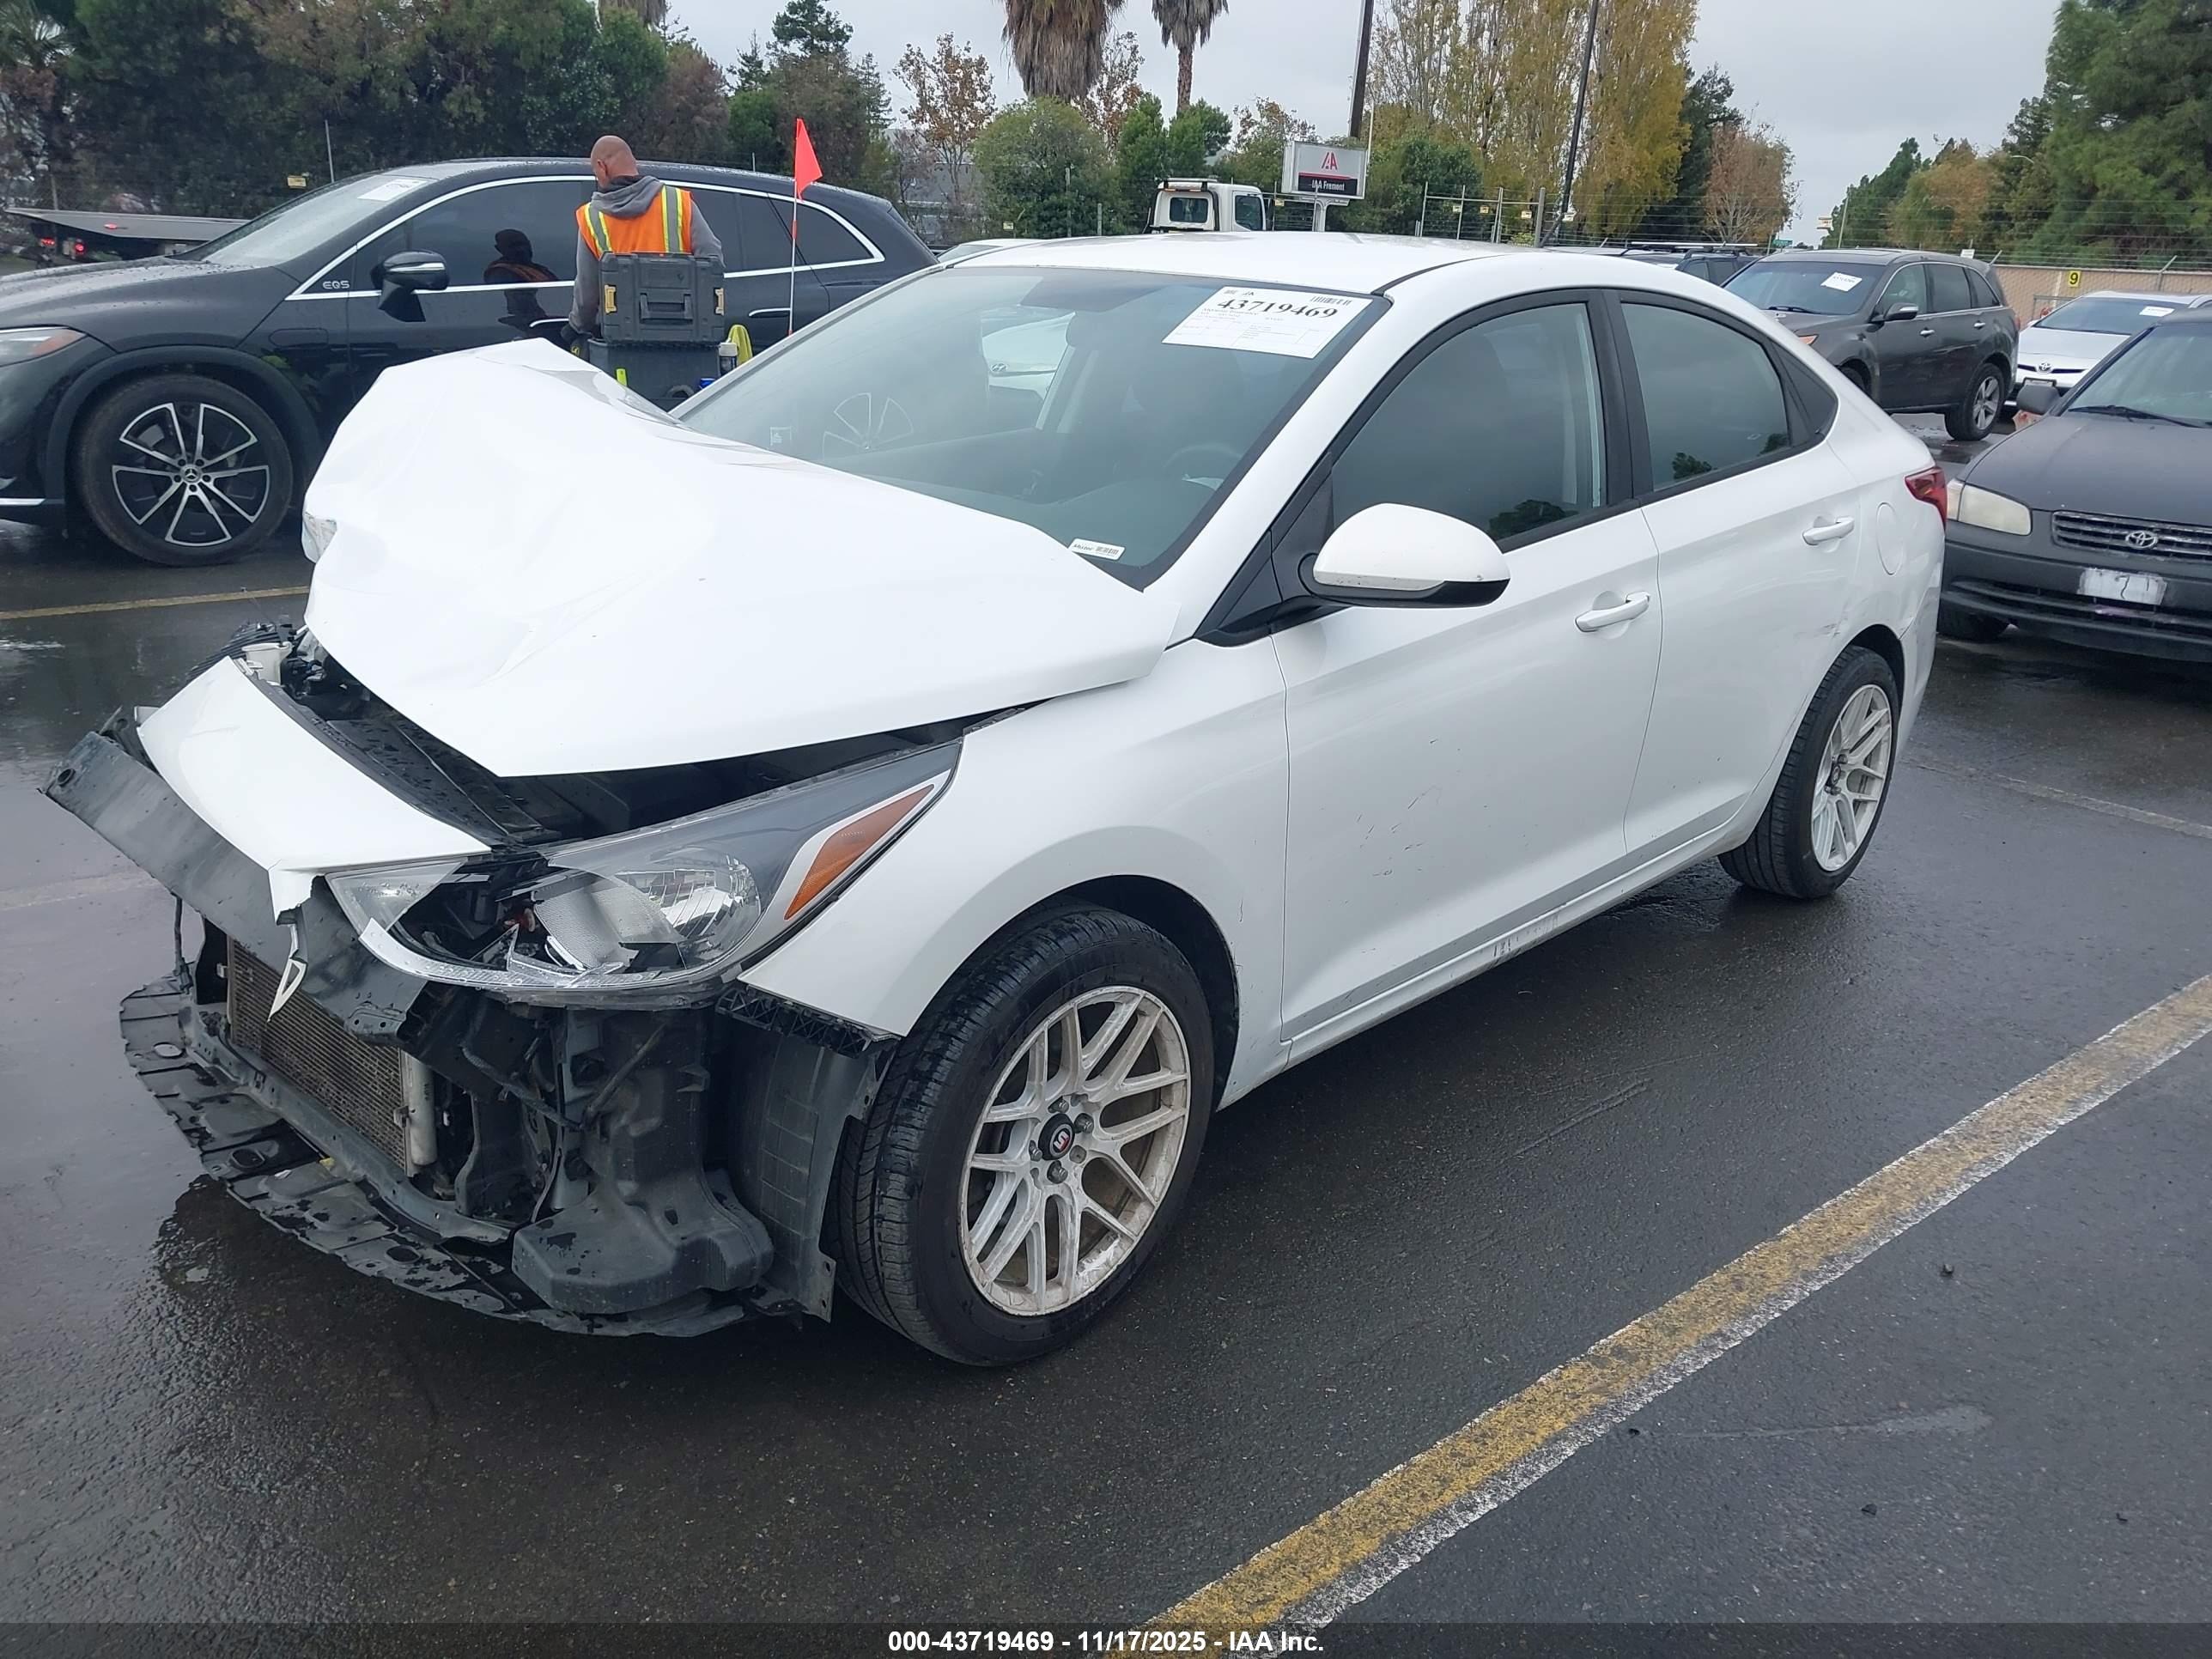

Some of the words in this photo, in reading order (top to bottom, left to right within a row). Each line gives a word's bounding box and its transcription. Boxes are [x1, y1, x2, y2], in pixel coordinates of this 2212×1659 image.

[1311, 179, 1322, 190] IAA
[1323, 180, 1345, 191] Fremont
[323, 280, 350, 289] EQS
[2069, 272, 2079, 285] 9
[1217, 298, 1339, 319] 43719469
